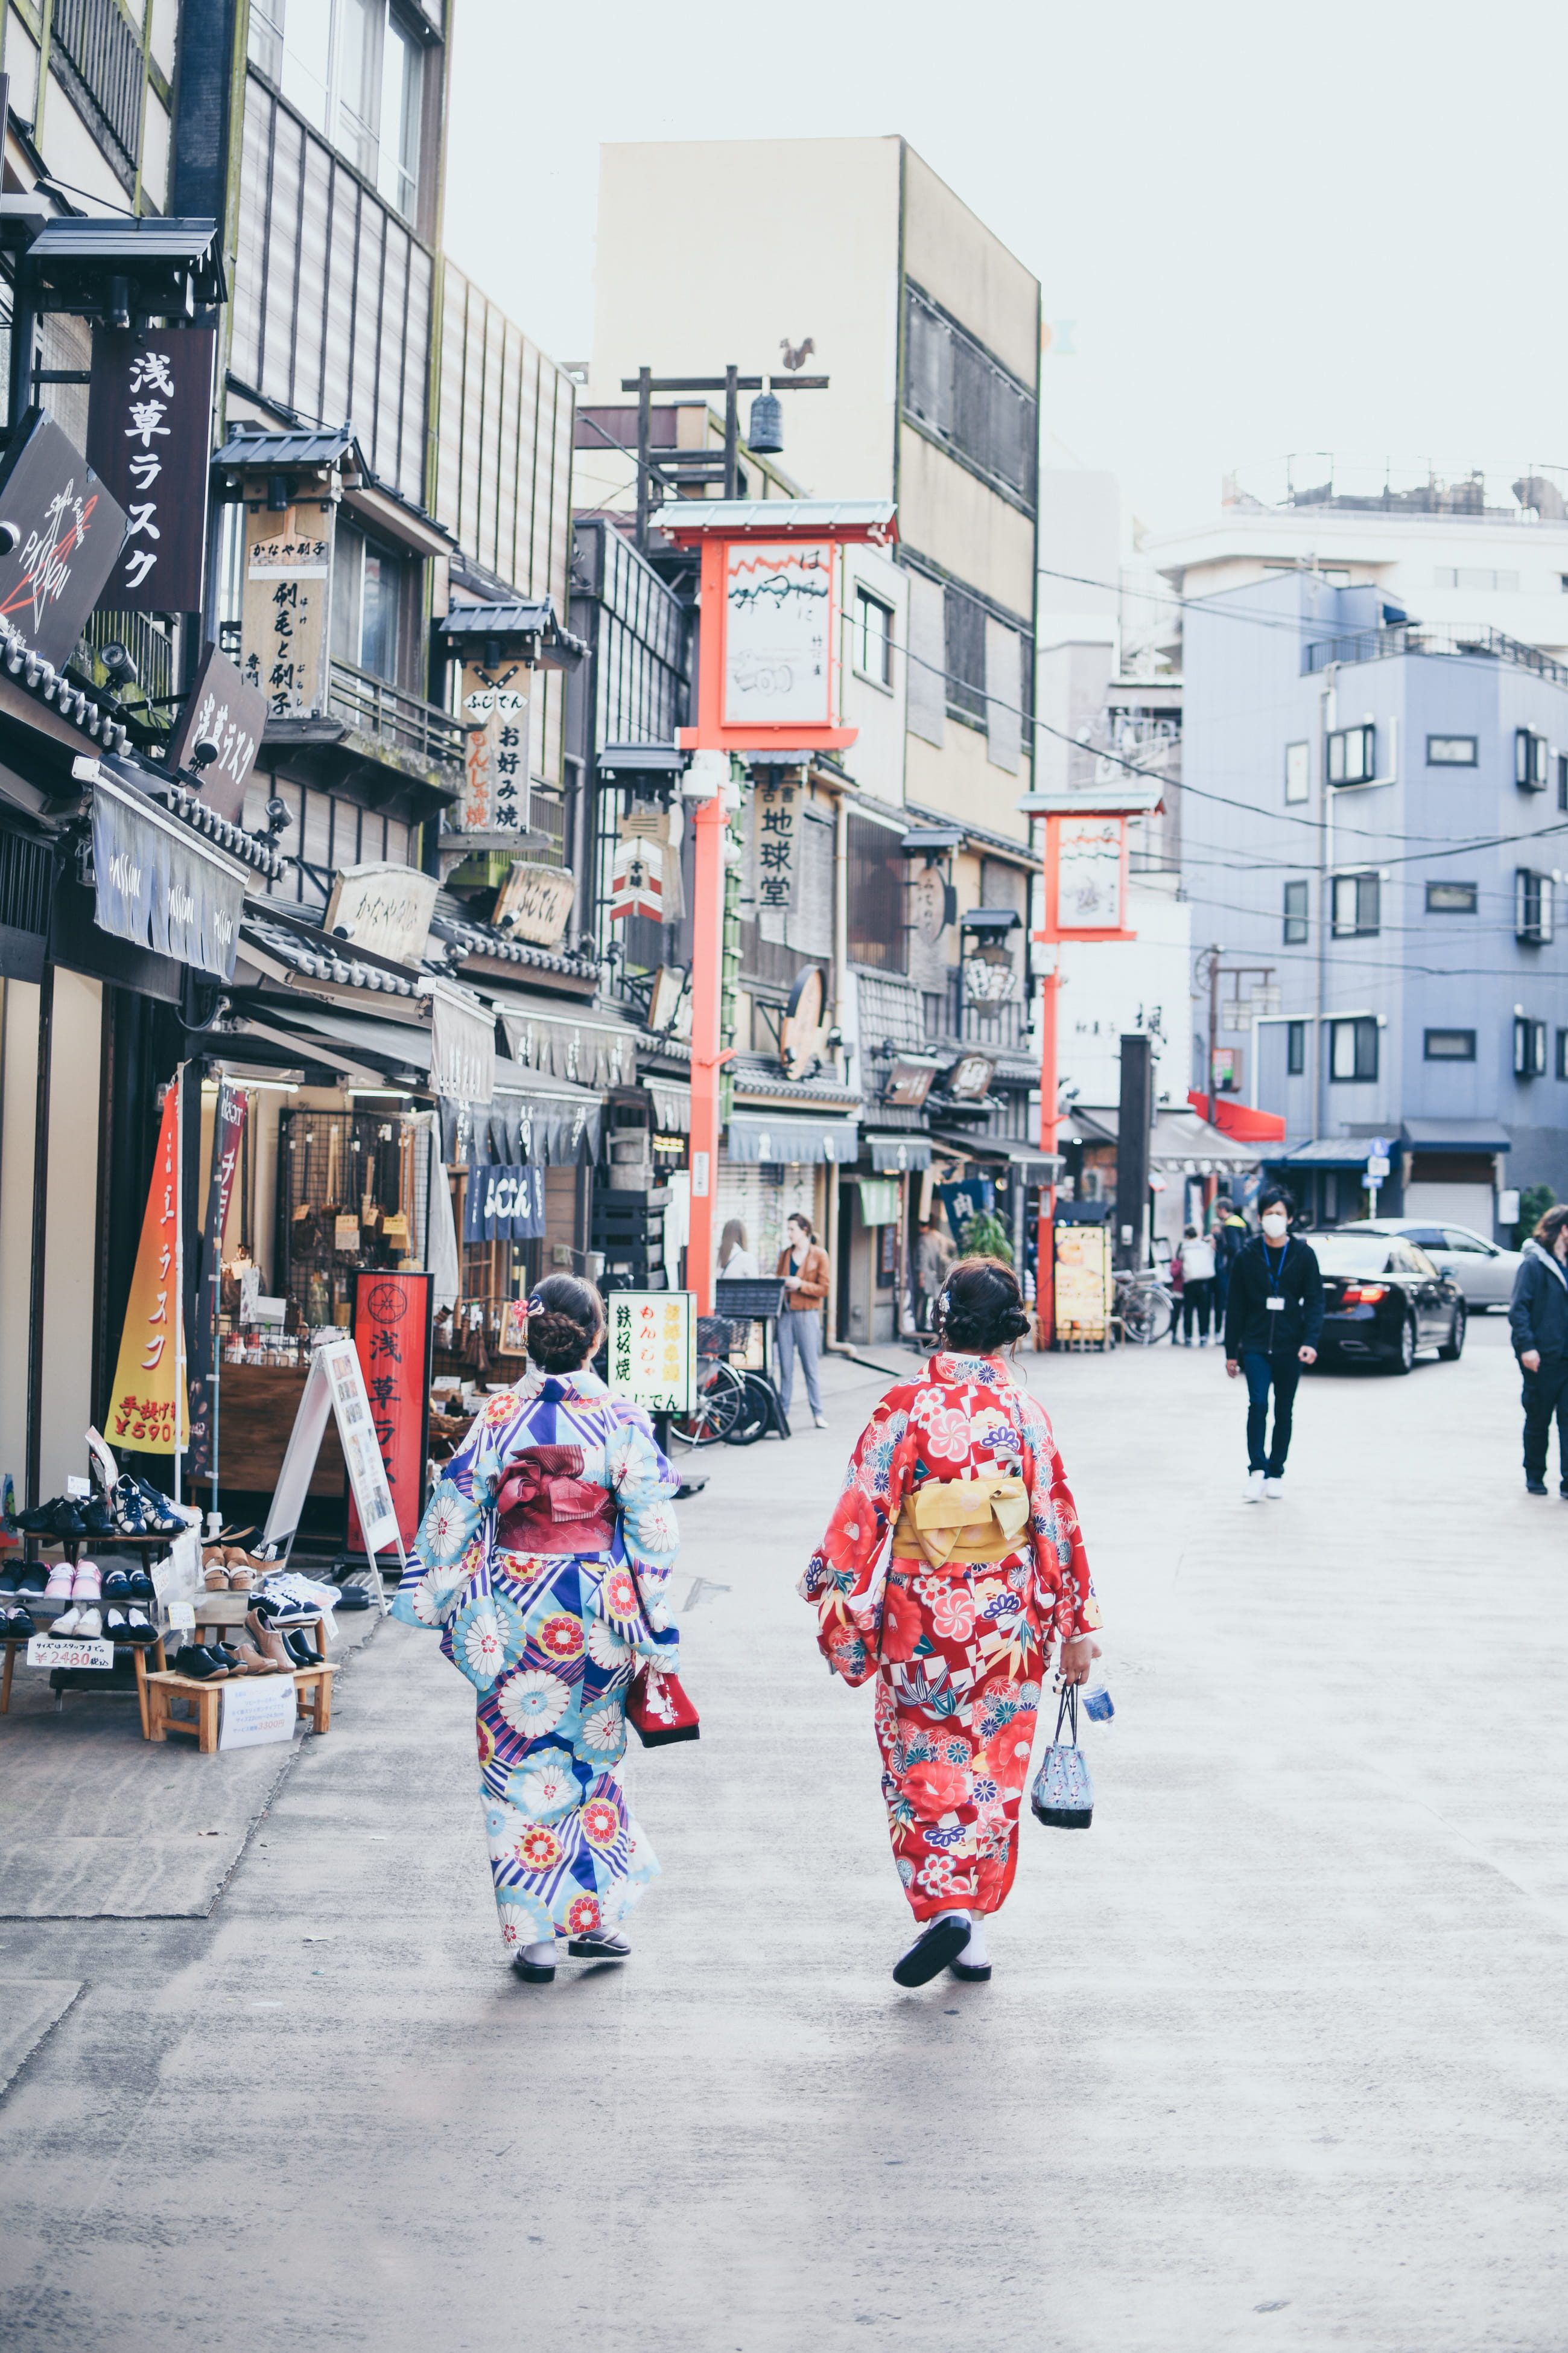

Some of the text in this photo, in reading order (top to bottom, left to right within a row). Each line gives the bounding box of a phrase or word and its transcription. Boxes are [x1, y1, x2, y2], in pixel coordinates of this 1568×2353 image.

[124, 352, 175, 588] 浅草ラスク
[253, 542, 325, 556] かなや刷子
[269, 582, 298, 715] 刷毛と刷子
[191, 692, 255, 785] 浅草ラスク
[467, 695, 523, 709] ふじでん
[496, 726, 520, 827] お好み焼
[760, 806, 793, 906] 地球堂
[616, 1304, 632, 1381] 鉄板焼
[115, 1415, 183, 1442] ¥590
[368, 1329, 402, 1504] 浅草ラス
[620, 1393, 680, 1410] じでん
